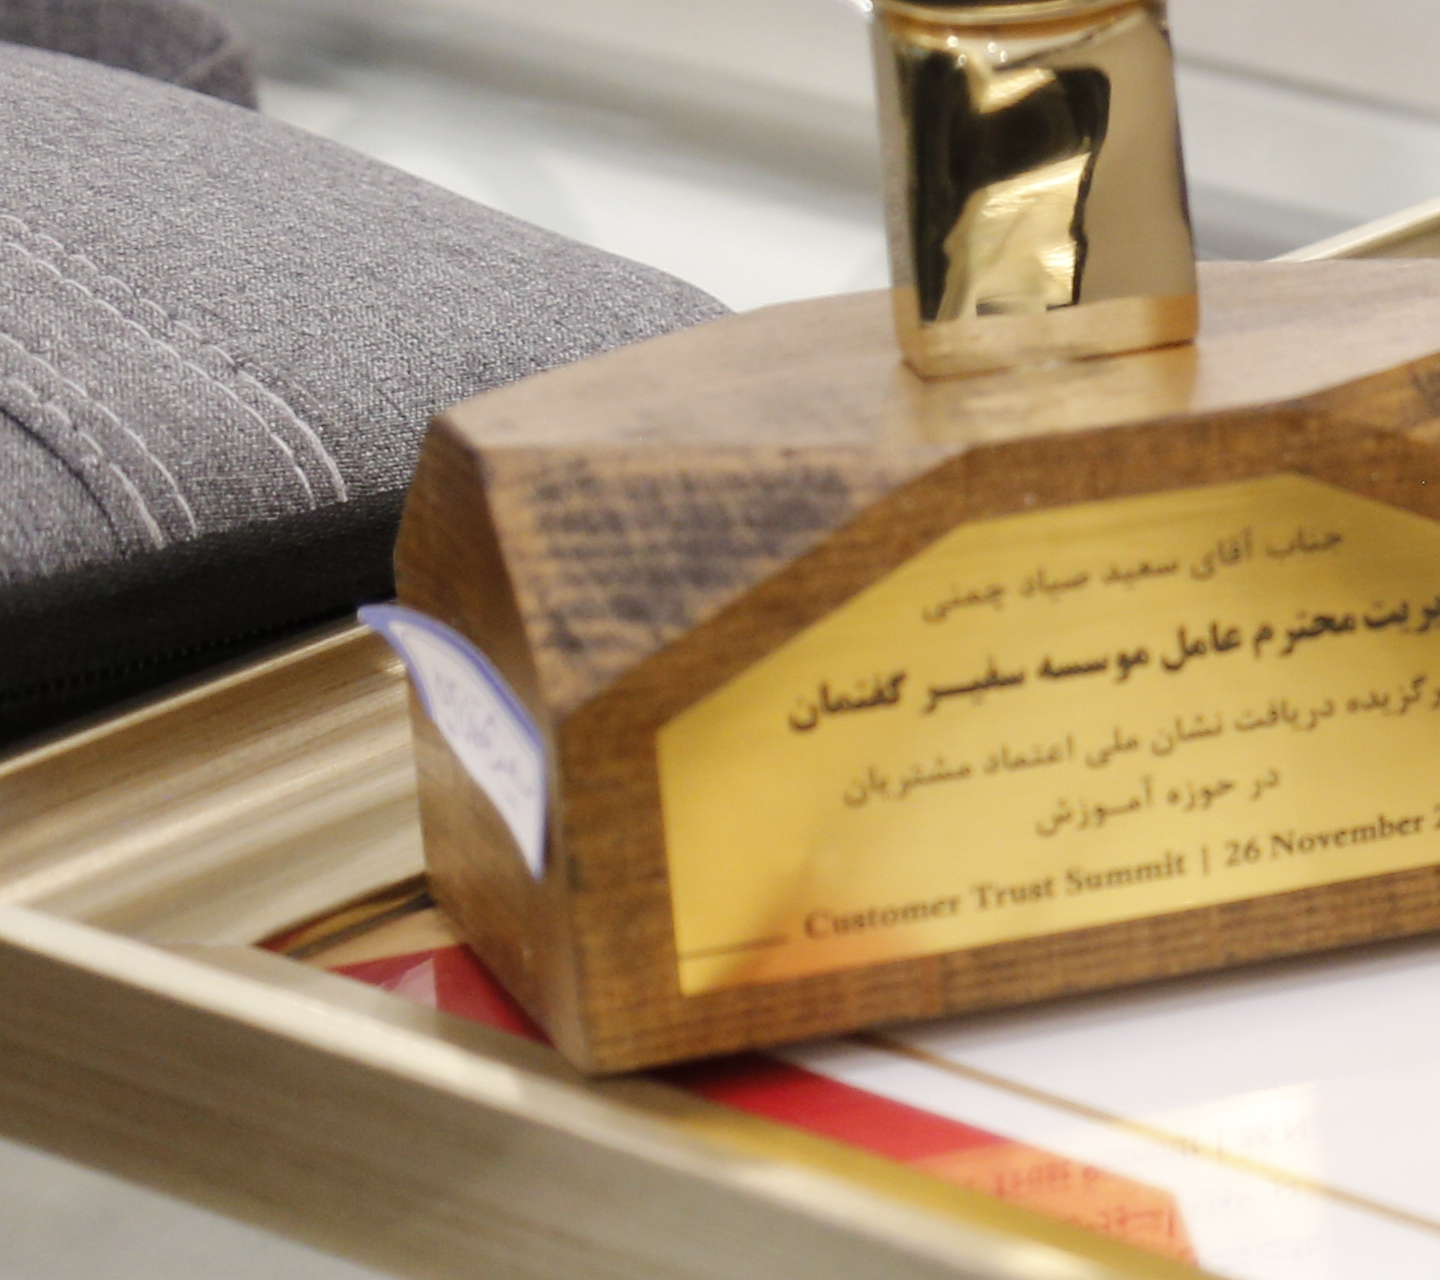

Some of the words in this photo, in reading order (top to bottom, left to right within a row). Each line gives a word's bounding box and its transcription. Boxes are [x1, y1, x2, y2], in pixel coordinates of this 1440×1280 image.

[1190, 523, 1253, 583] آقای
[1264, 528, 1345, 565] جناب
[1102, 560, 1181, 590] سعید
[1160, 619, 1244, 672] عامل
[1251, 609, 1357, 660] محترم
[919, 656, 1027, 717] سفیر
[1037, 645, 1151, 686] موسسه
[787, 668, 908, 733] گفتمان
[1233, 697, 1337, 733] دریافت
[982, 732, 1077, 774] اعتماد
[1085, 726, 1141, 769] ملی
[1150, 712, 1225, 757] نشان
[842, 754, 973, 809] مشتریان
[1165, 778, 1237, 813] حوزه
[1249, 768, 1282, 801] در
[1033, 772, 1153, 840] آموزش
[801, 890, 963, 941] Customer
[969, 876, 1057, 913] Trust
[1063, 849, 1188, 899] Summit
[1224, 836, 1263, 869] 26
[1269, 810, 1427, 861] November
